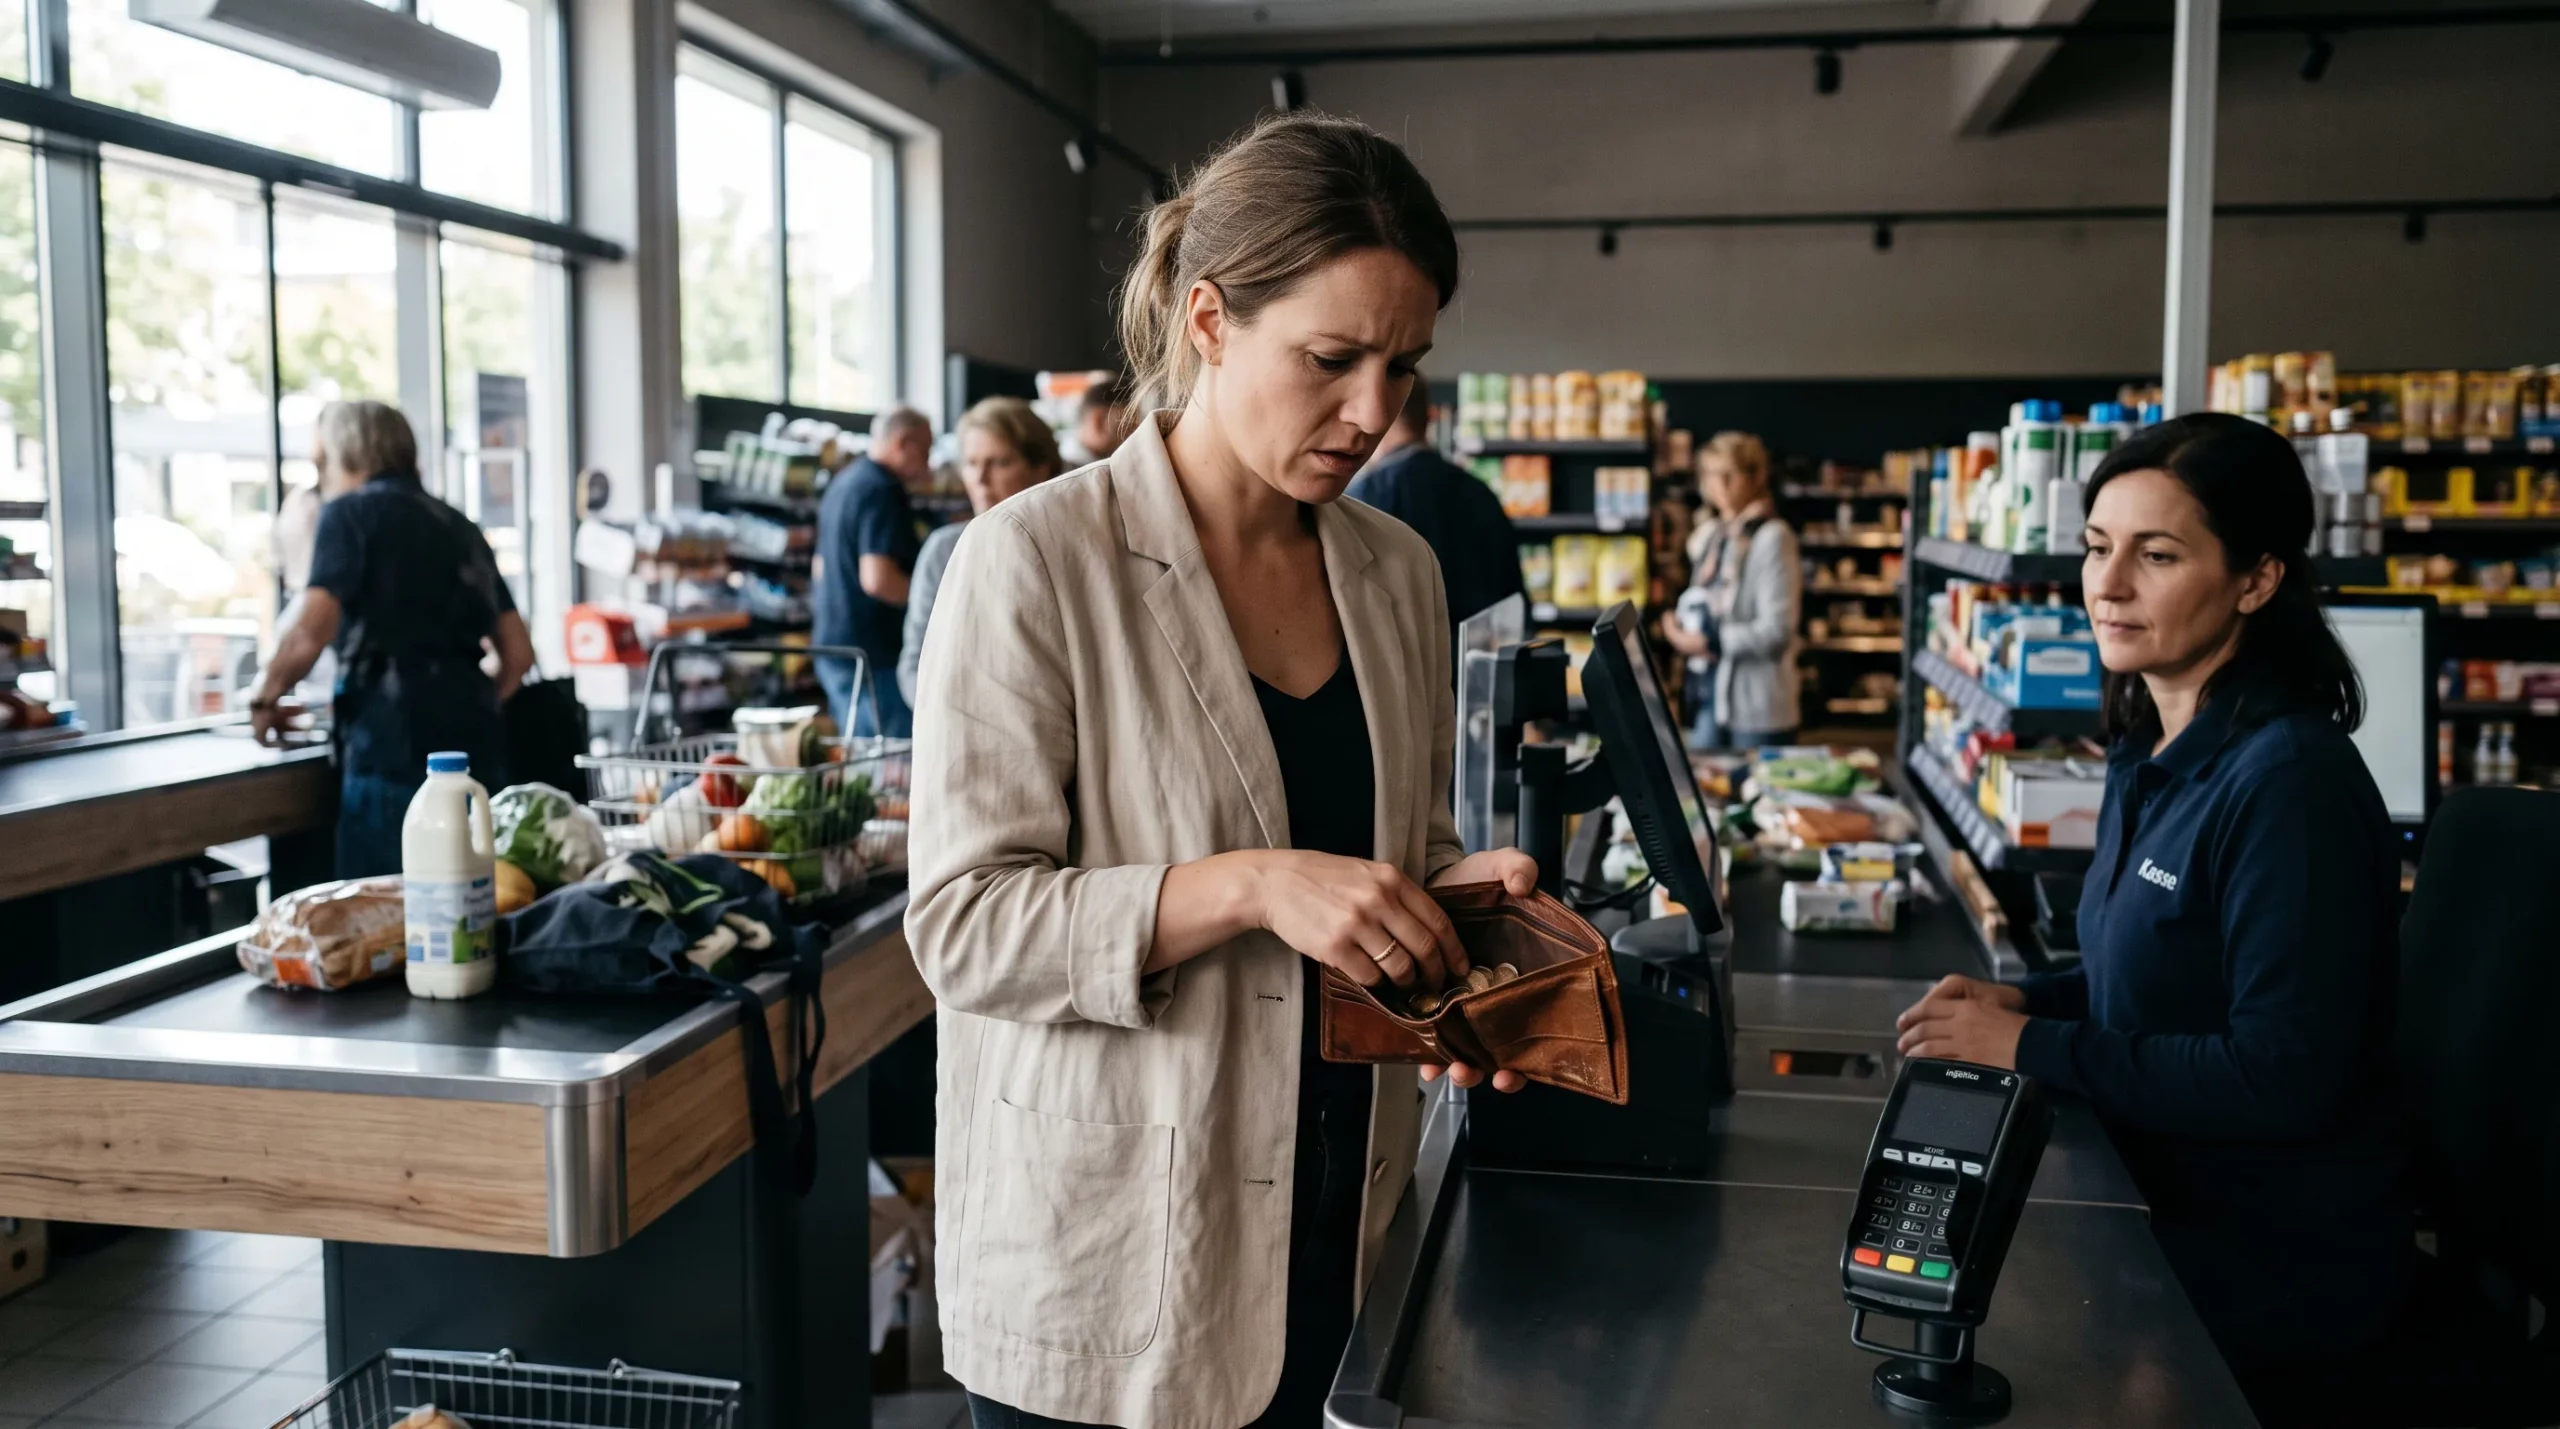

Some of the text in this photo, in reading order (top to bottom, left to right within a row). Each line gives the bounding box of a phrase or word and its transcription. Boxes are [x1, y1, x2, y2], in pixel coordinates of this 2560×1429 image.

[2138, 857, 2178, 891] Kasse
[1913, 1184, 1922, 1194] 2
[1948, 1190, 1956, 1199] 3
[1902, 1221, 1910, 1230] 8
[1896, 1239, 1905, 1248] 0
